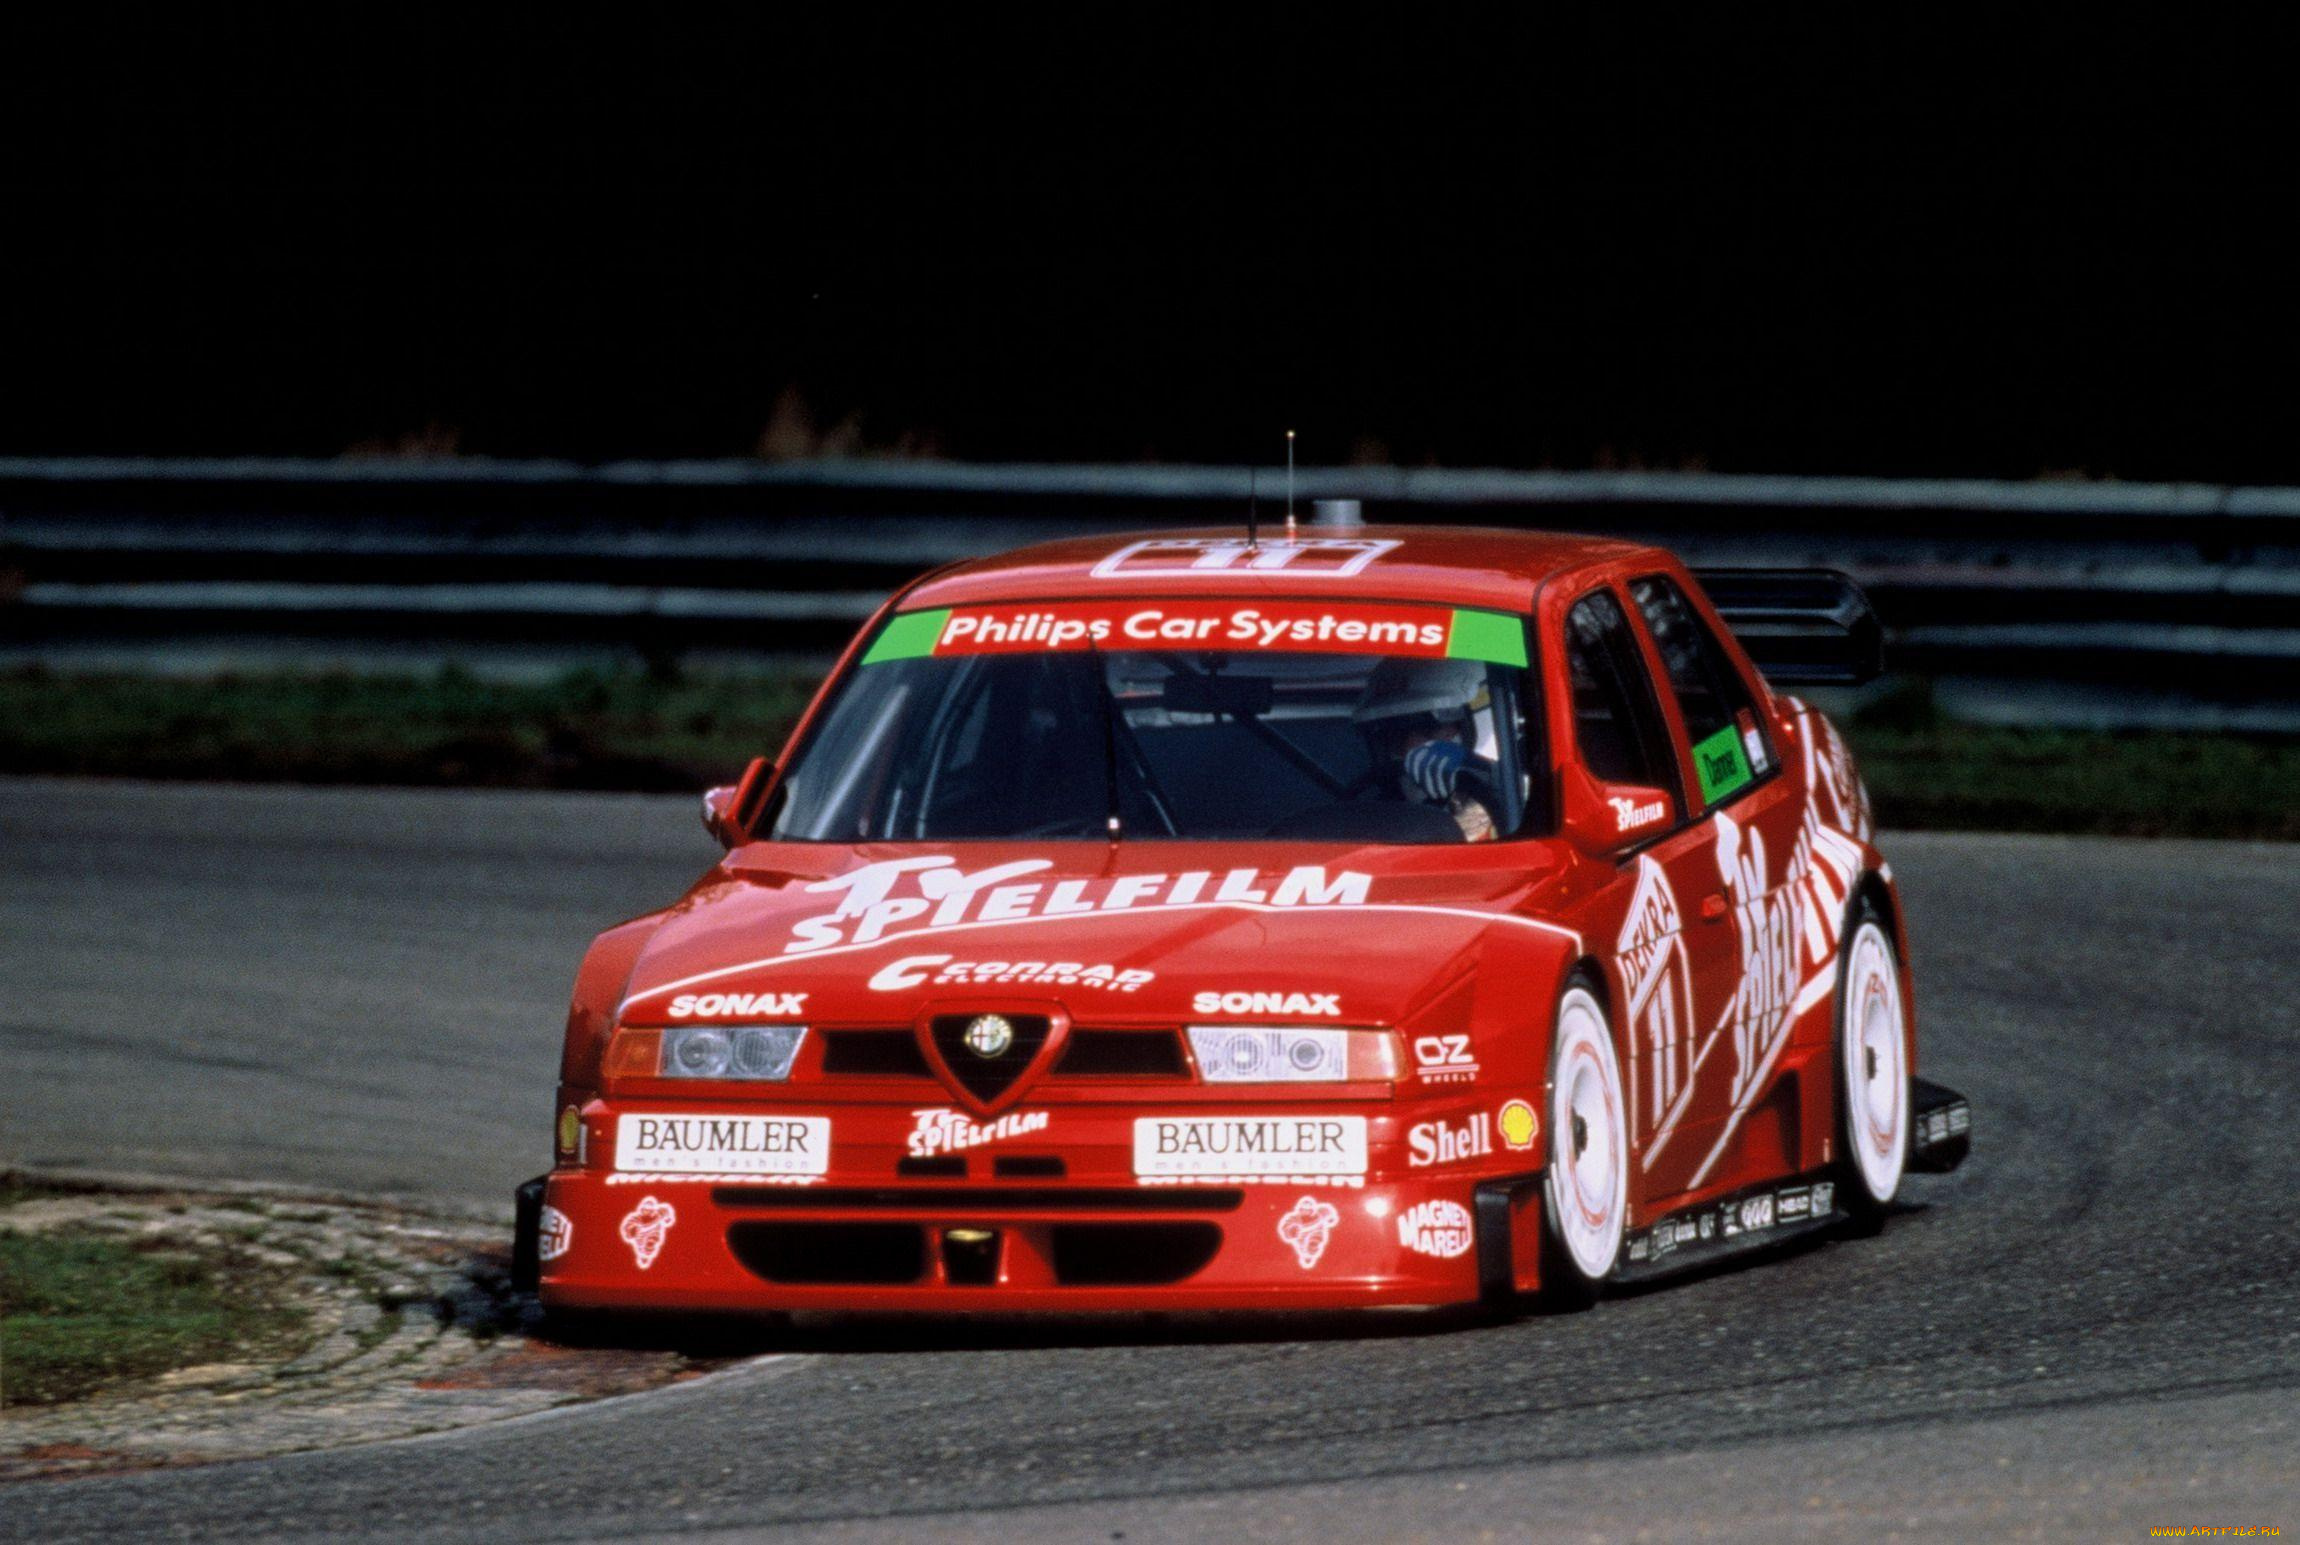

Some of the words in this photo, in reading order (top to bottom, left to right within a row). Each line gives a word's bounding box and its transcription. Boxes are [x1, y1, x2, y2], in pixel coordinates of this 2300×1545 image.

[941, 613, 1111, 646] Philips
[1123, 610, 1220, 639] Car
[1227, 610, 1444, 646] Systems
[783, 866, 1374, 953] SPIELFILM
[1621, 875, 1675, 1004] DEKRA
[668, 992, 810, 1018] SONAX
[1192, 992, 1342, 1016] SONAX
[1415, 1034, 1474, 1065] OZ
[636, 1119, 809, 1153] BÄUMLER
[907, 1111, 1050, 1157] SPIELFILM
[1156, 1121, 1346, 1154] BÄUMLER
[1408, 1112, 1493, 1166] Shell
[718, 1156, 809, 1170] fashion
[1248, 1157, 1347, 1170] fashion
